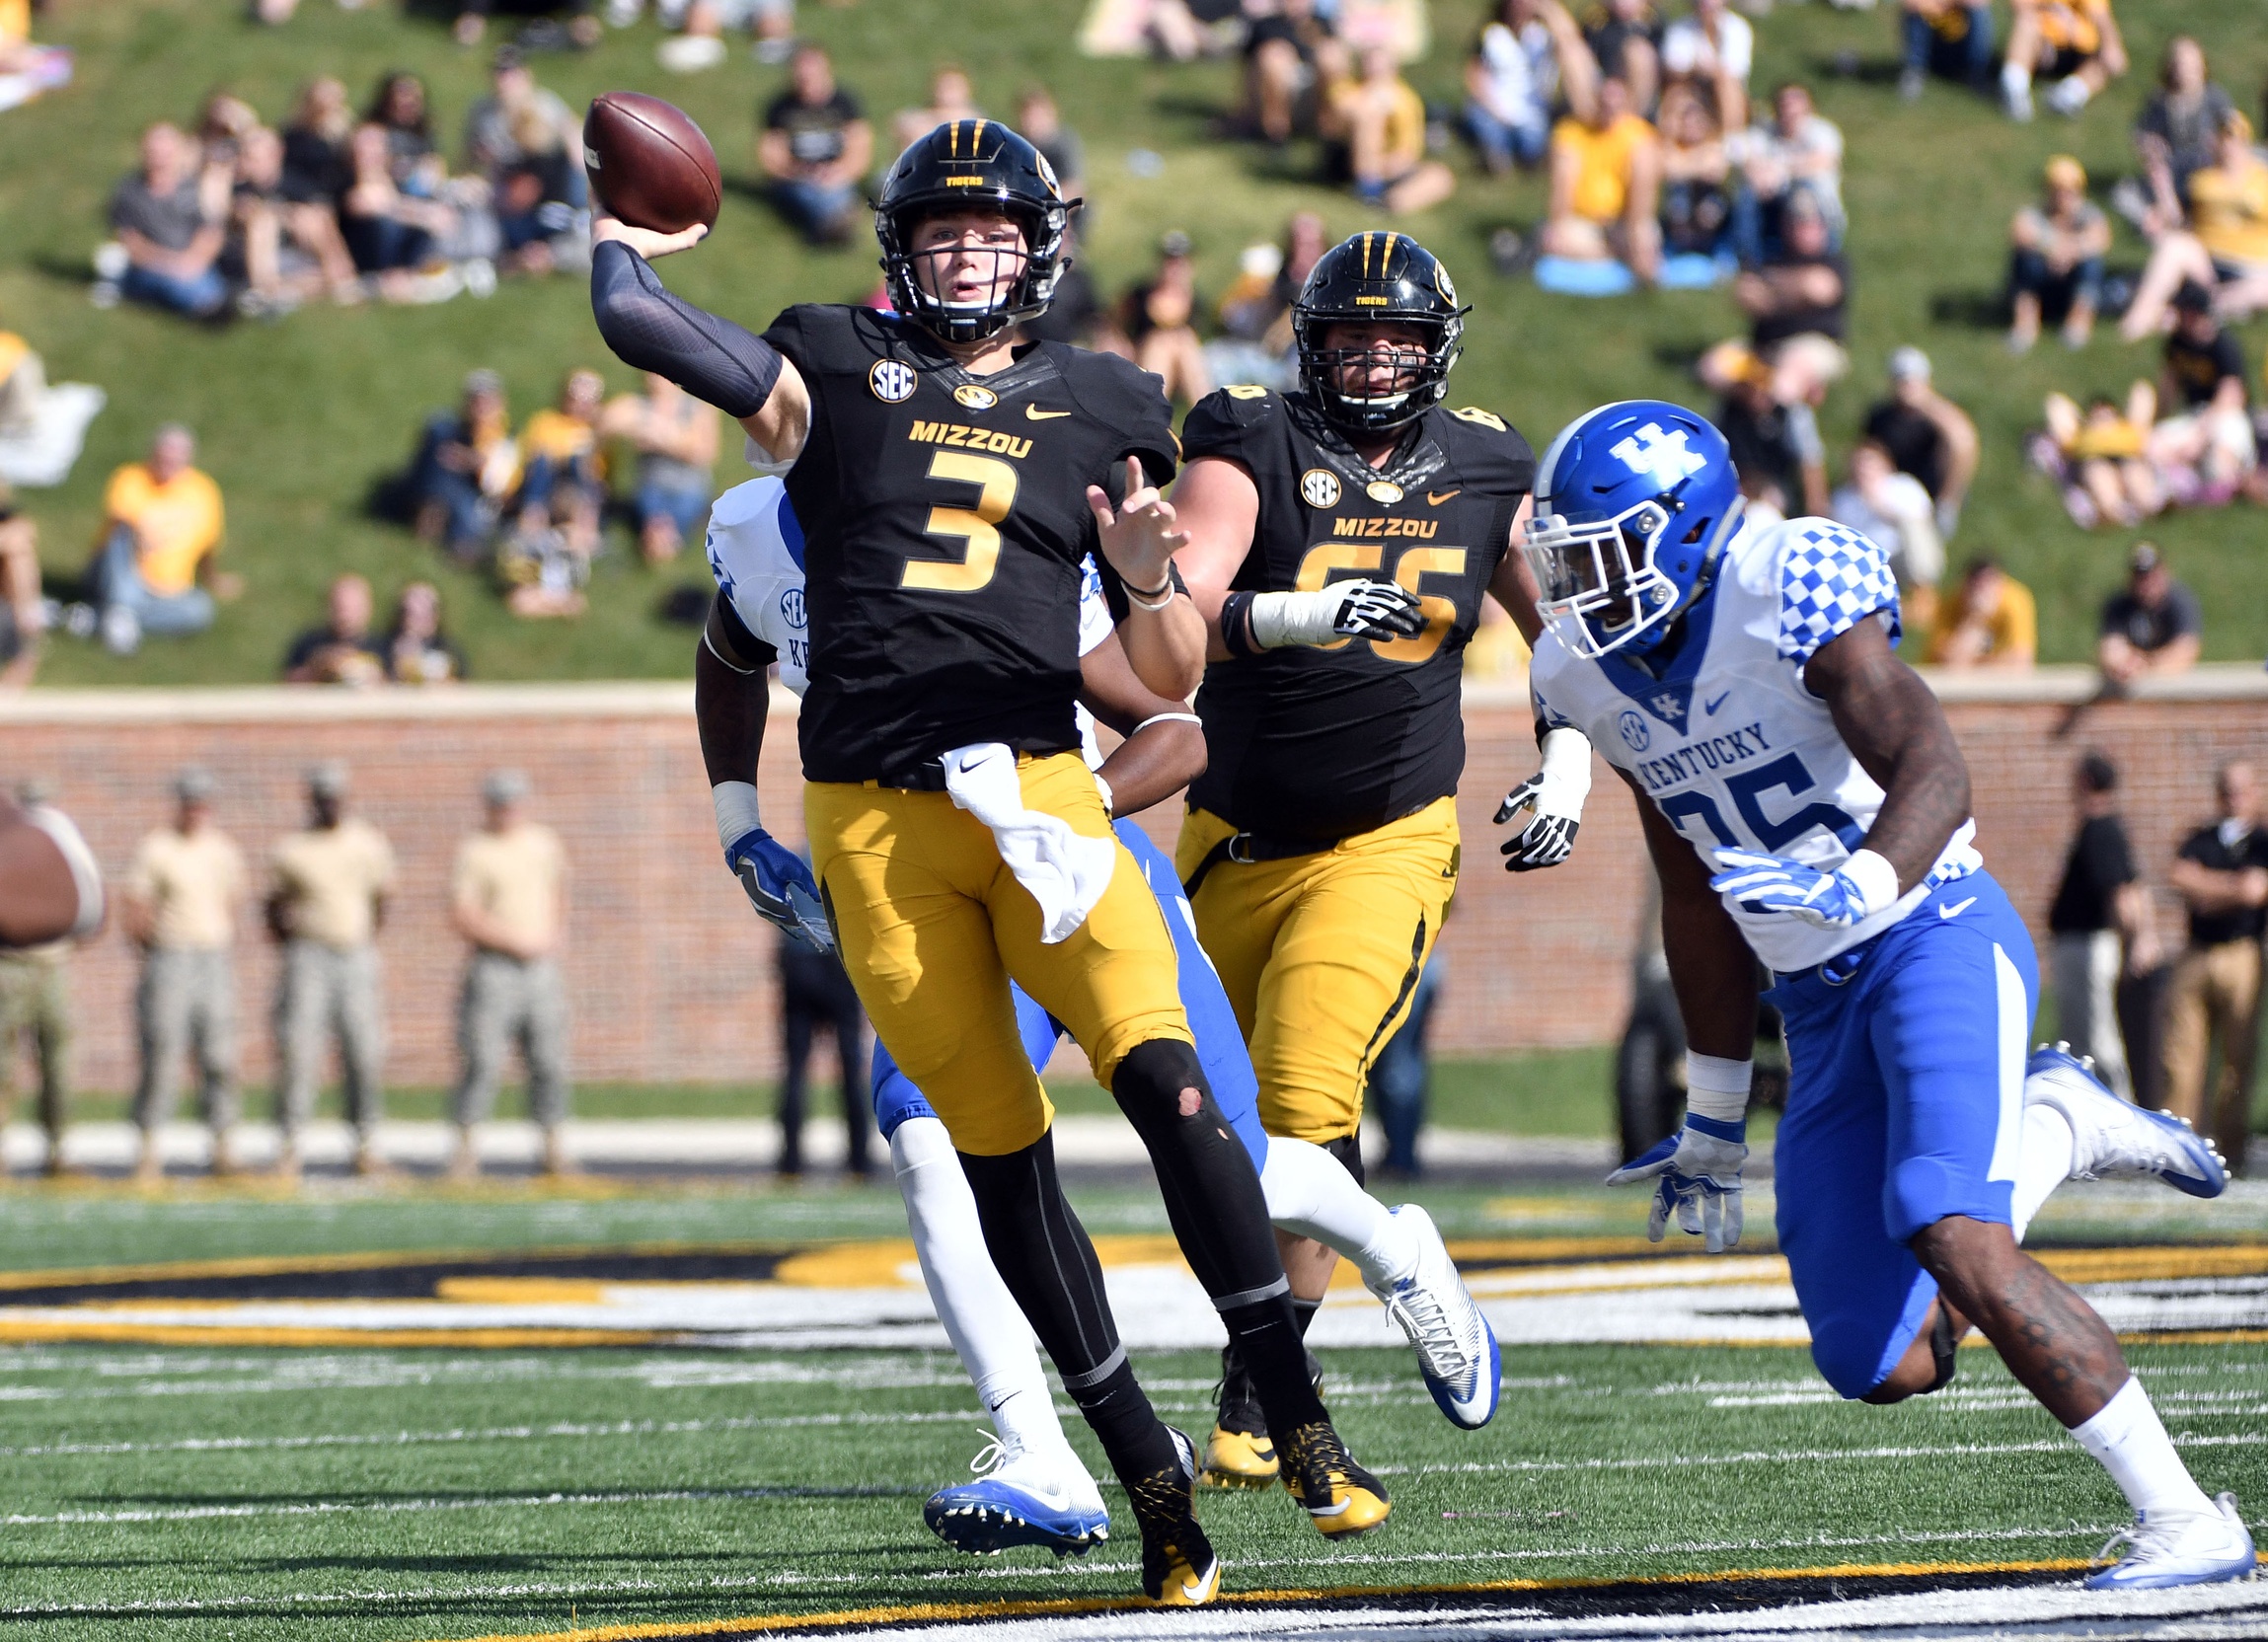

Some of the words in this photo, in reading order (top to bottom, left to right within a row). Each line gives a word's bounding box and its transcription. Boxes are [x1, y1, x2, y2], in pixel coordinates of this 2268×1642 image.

[946, 176, 983, 187] TIGERS
[1356, 297, 1388, 306] TIGERS
[873, 361, 914, 400] SEC
[909, 420, 1033, 459] MIZZOU
[1609, 422, 1707, 490] UK
[1305, 472, 1337, 505] SEC
[898, 447, 1020, 592] 3
[1333, 518, 1438, 538] MIZZOU
[1650, 693, 1685, 719] UK
[1620, 713, 1647, 750] SEC
[1637, 723, 1770, 789] KENTUCKY
